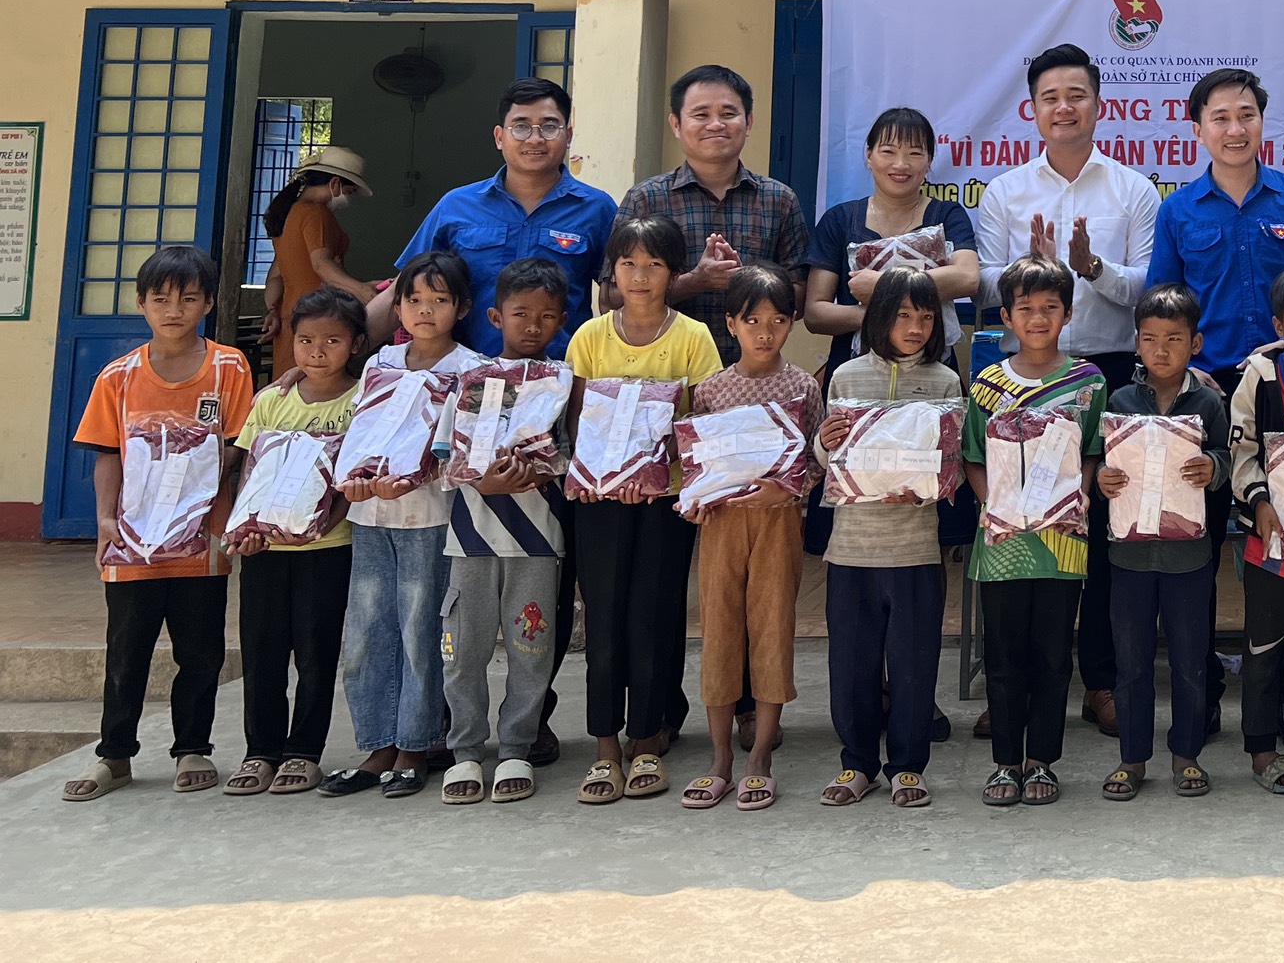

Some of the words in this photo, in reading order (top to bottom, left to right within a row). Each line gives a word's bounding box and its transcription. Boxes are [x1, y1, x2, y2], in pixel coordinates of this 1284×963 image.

[1110, 56, 1125, 66] CƠ
[1128, 58, 1157, 67] QUAN
[1160, 56, 1175, 66] VÀ
[1177, 58, 1214, 66] DOANH
[1217, 55, 1258, 67] NGHIỆP
[1101, 70, 1126, 81] OÀN
[1131, 69, 1147, 82] SỞ
[1150, 70, 1171, 81] TÀI
[981, 135, 1030, 166] ĐÀN
[1093, 135, 1144, 166] HÂN
[1153, 135, 1197, 166] YÊU
